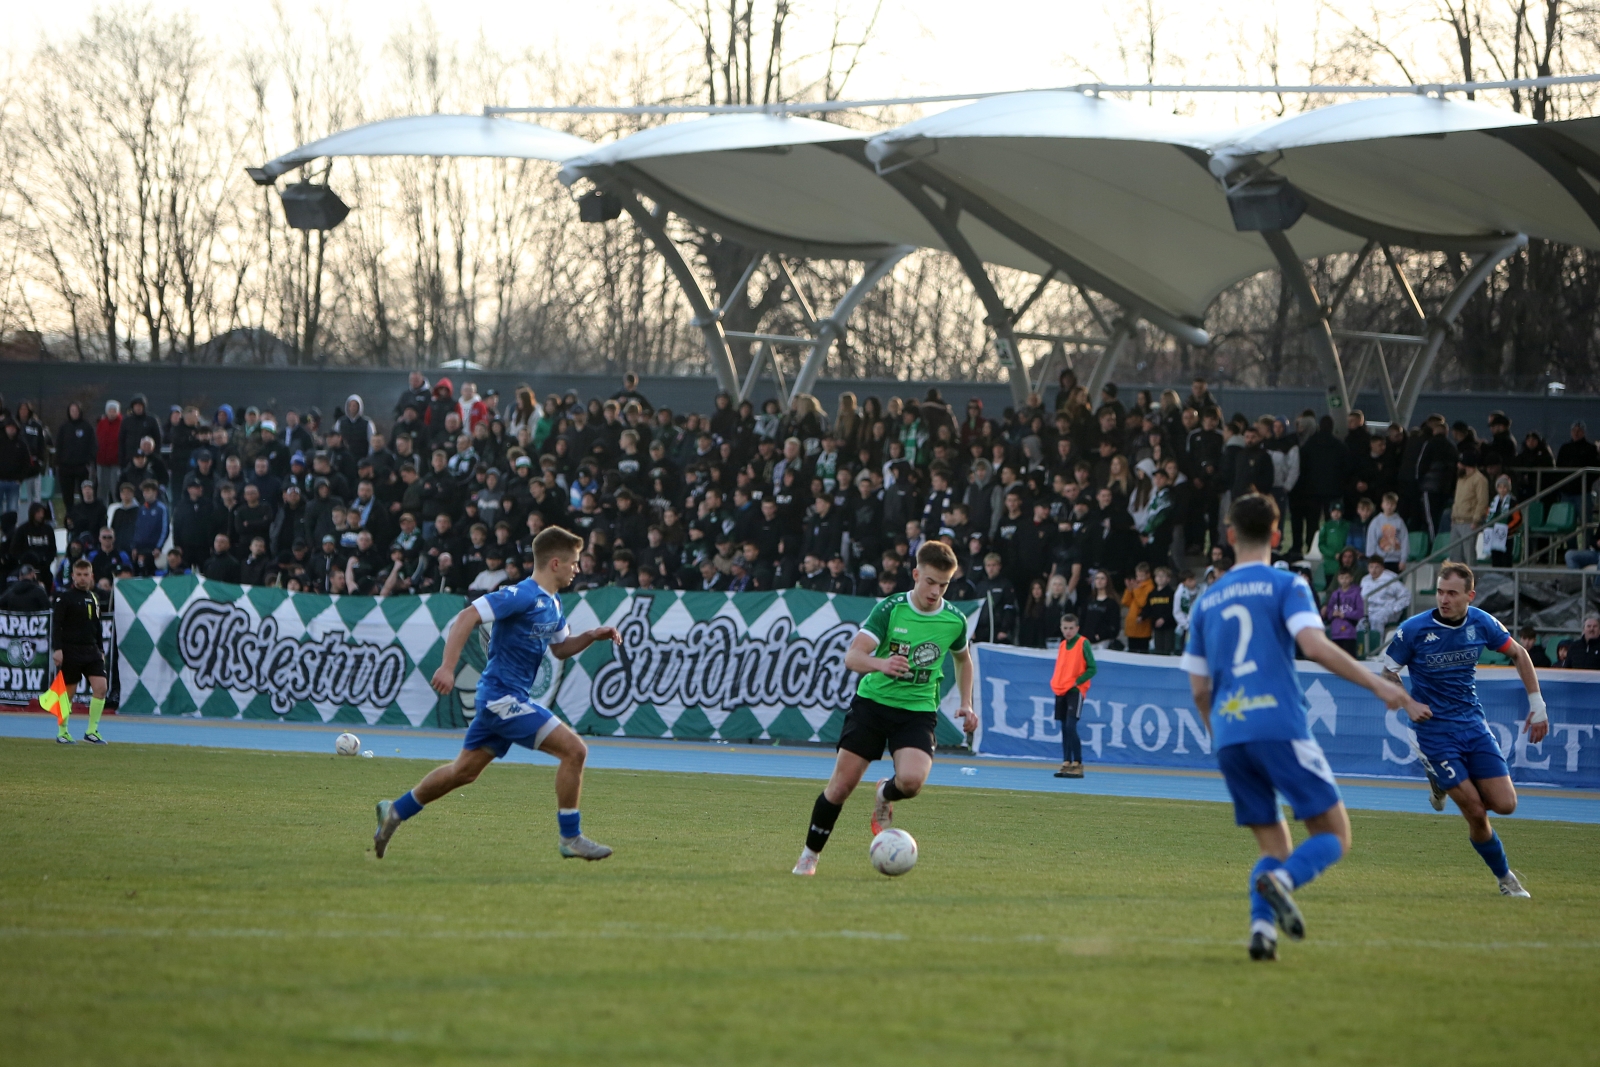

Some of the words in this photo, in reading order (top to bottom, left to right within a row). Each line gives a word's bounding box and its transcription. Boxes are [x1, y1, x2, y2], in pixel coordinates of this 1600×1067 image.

[178, 599, 406, 715] Księstwo
[590, 595, 866, 718] Świdnicki
[1221, 604, 1258, 678] 2
[0, 667, 44, 691] PDW
[1440, 760, 1456, 779] 5
